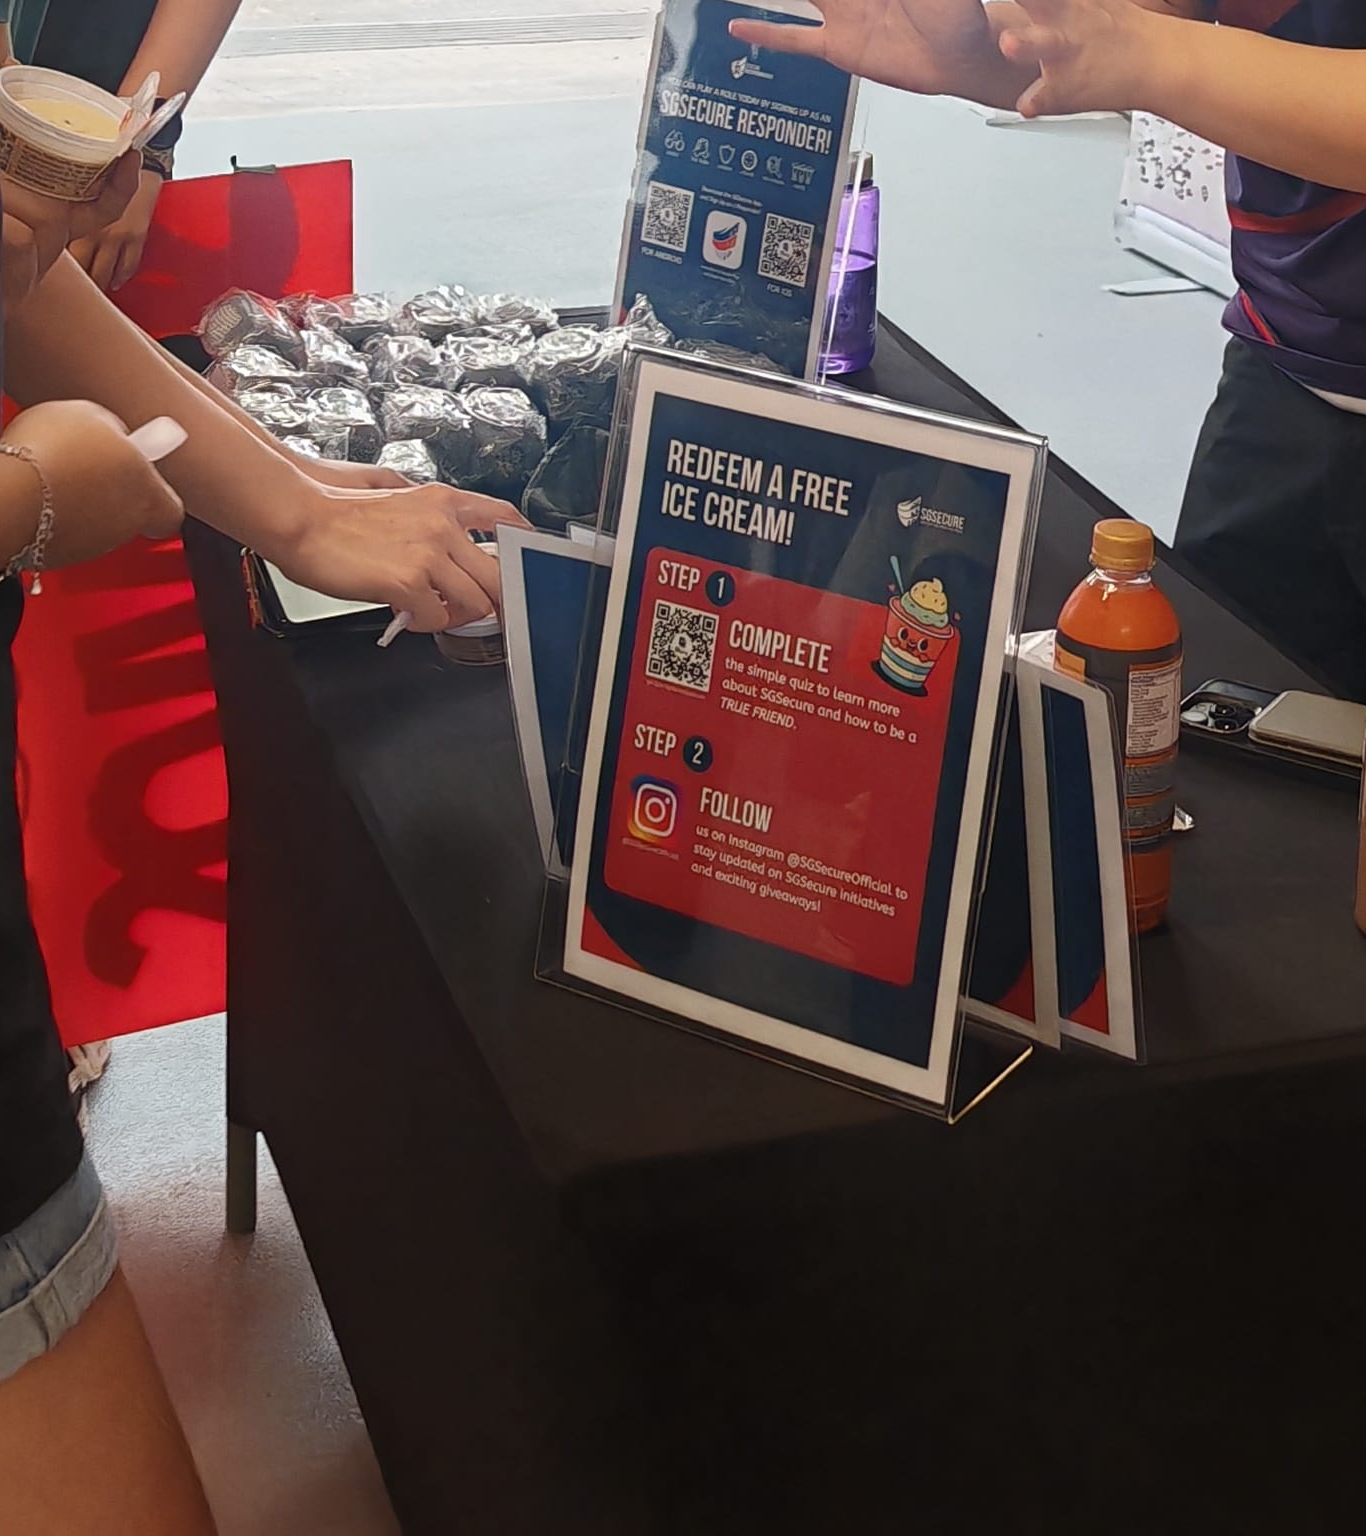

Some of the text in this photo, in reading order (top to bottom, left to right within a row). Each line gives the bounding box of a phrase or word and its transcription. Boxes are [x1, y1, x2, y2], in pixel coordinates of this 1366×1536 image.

[660, 89, 832, 155] SGSECURE RESPONDER!
[667, 439, 852, 516] REDEEM A FREE
[661, 480, 795, 546] ICE CREAM!
[920, 507, 966, 530] SGSECURE
[658, 559, 725, 599] STEP 1
[729, 620, 832, 673] COMPLETE
[720, 696, 797, 730] TRUE FRIEND.
[722, 678, 758, 697] about
[760, 688, 815, 714] SGSecure
[818, 705, 841, 721] and
[844, 712, 870, 730] how
[873, 720, 886, 735] to
[890, 724, 905, 740] be
[908, 732, 917, 744] a
[725, 657, 900, 717] the simple quiz to learn more
[634, 723, 704, 765] STEP 2
[700, 786, 773, 833] FOLLOW
[691, 862, 821, 912] and exciting giveaways!
[693, 844, 717, 861] stay
[719, 851, 766, 876] updated
[767, 868, 783, 881] on
[785, 871, 837, 898] SGSecure
[840, 887, 896, 917] initiatives
[696, 825, 908, 900] us on Instagram @SGSecureOfficial to
